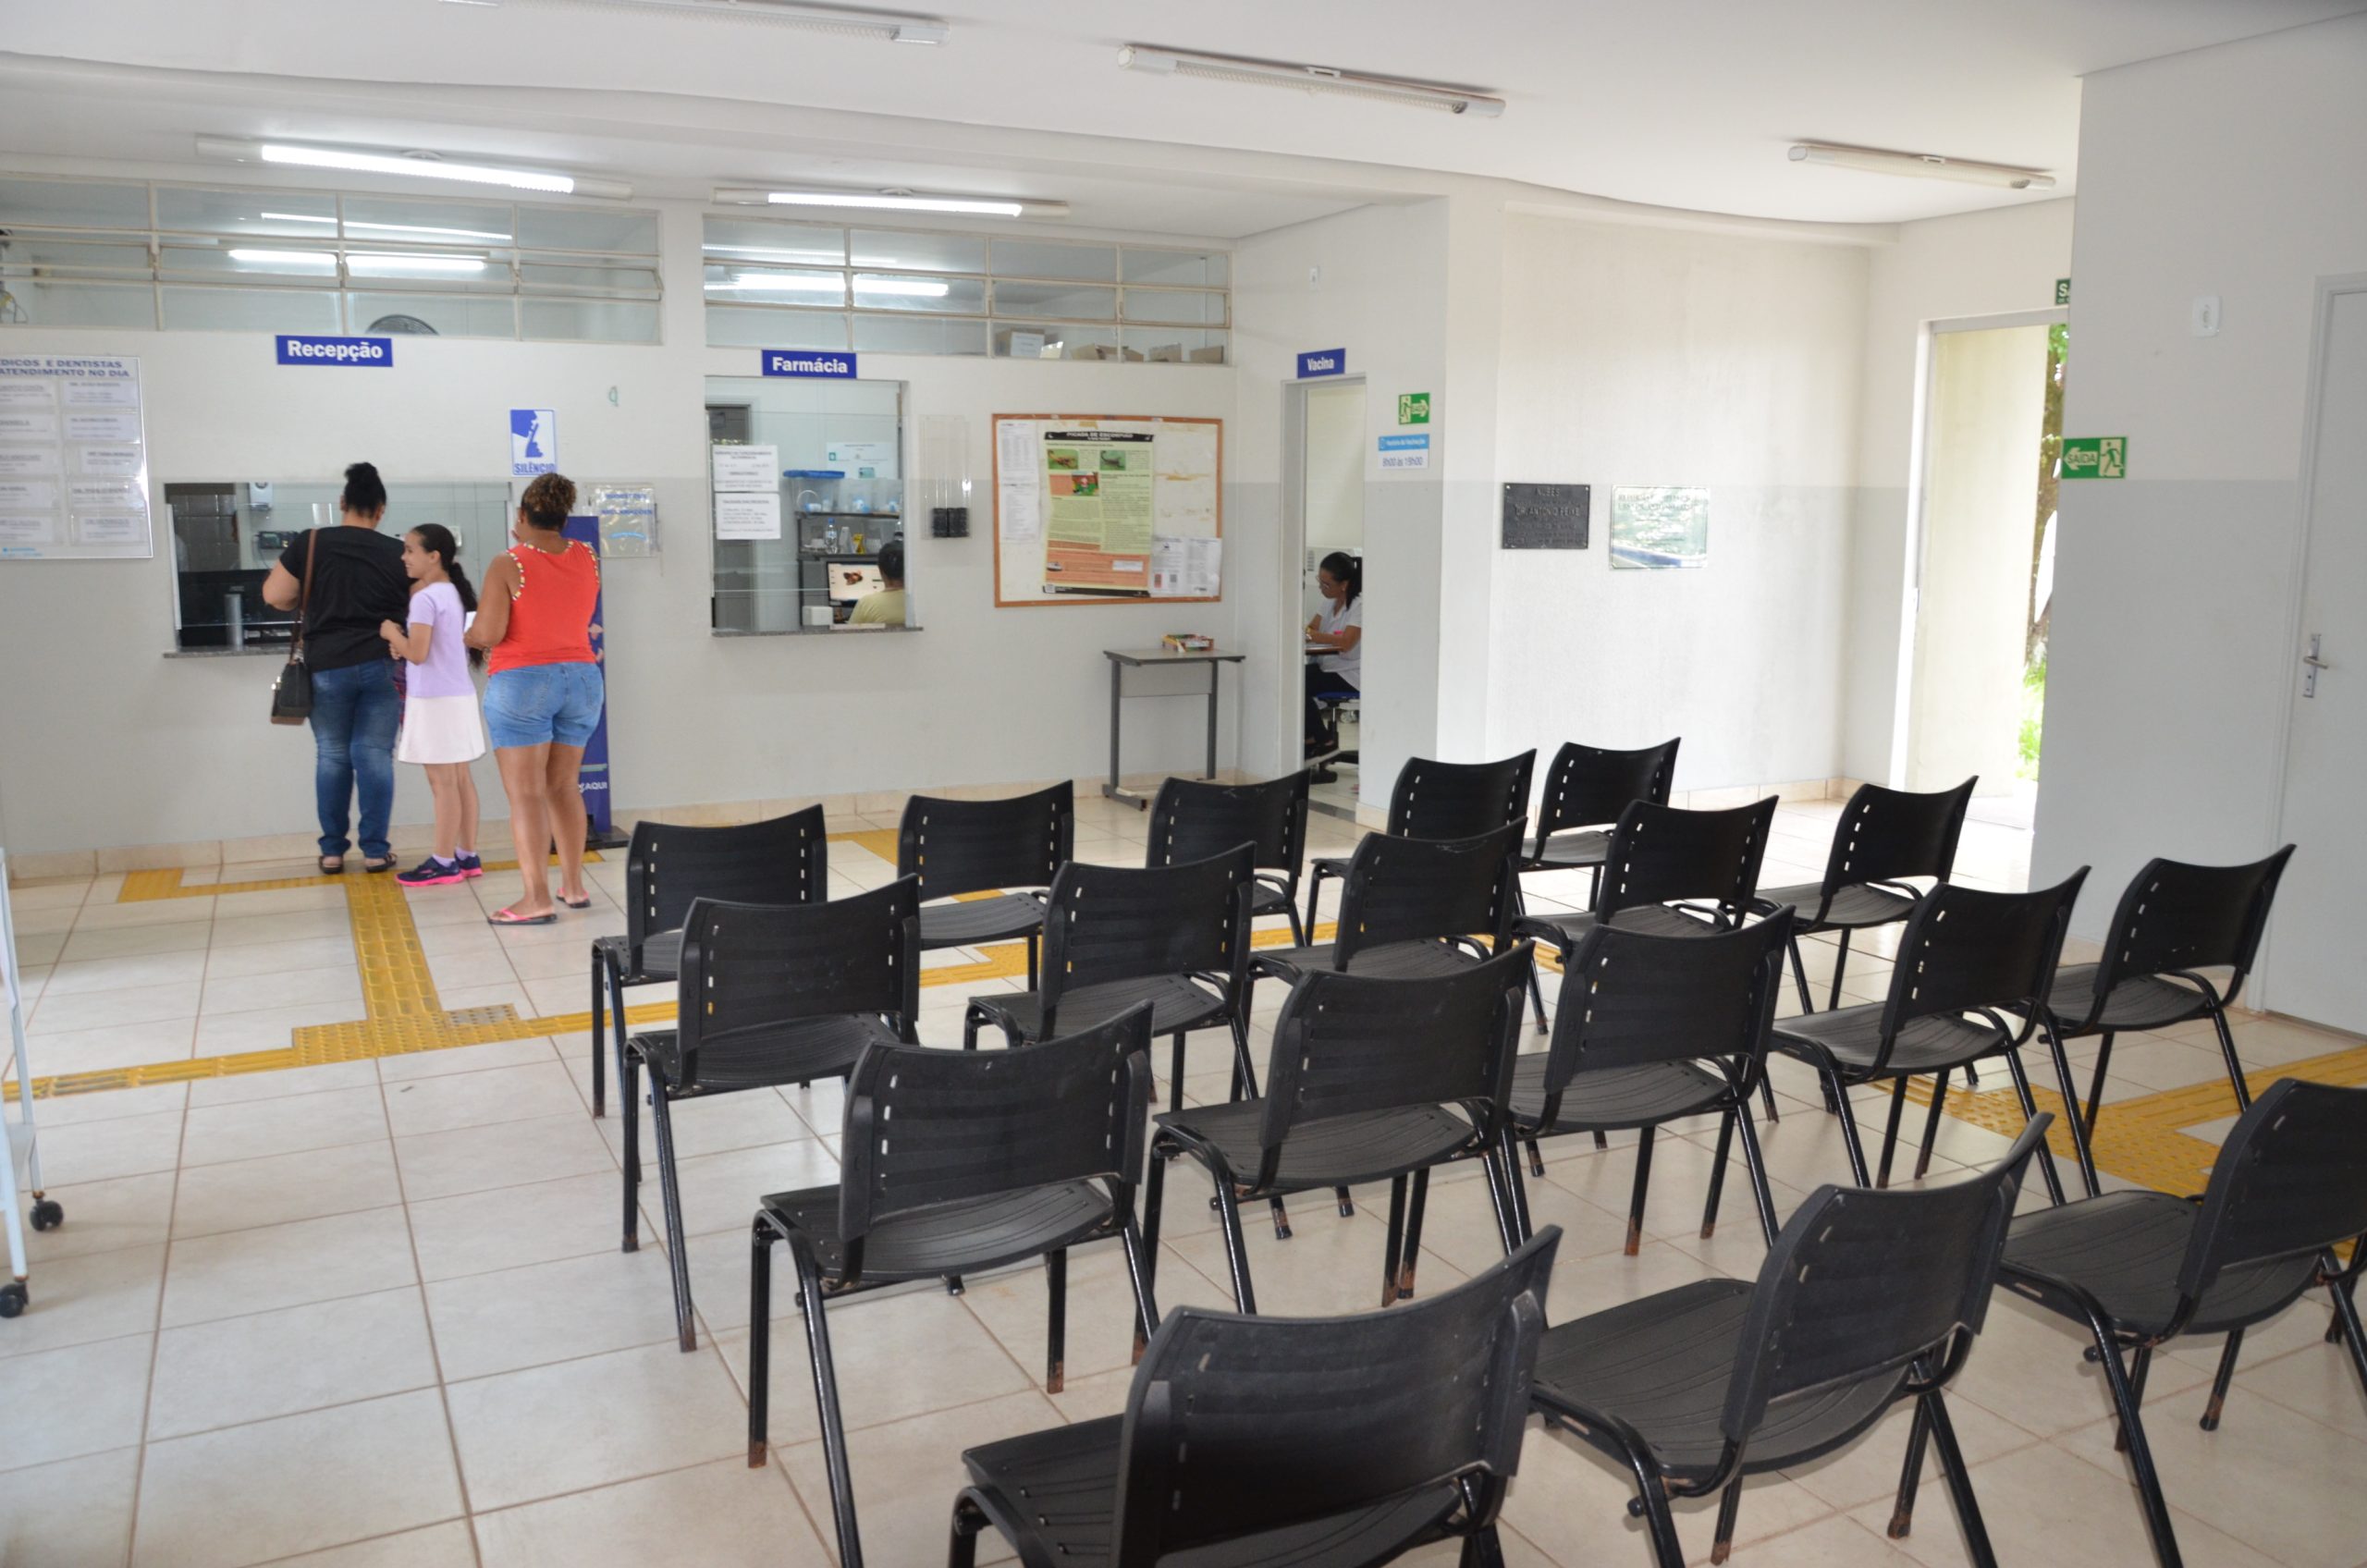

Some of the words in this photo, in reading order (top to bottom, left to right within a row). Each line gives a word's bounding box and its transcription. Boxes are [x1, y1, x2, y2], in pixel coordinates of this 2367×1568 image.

[288, 339, 384, 362] Recepção
[56, 360, 122, 368] DENTISTAS
[772, 356, 848, 374] Farmácia
[1306, 357, 1334, 372] Vacina
[89, 369, 106, 377] NO
